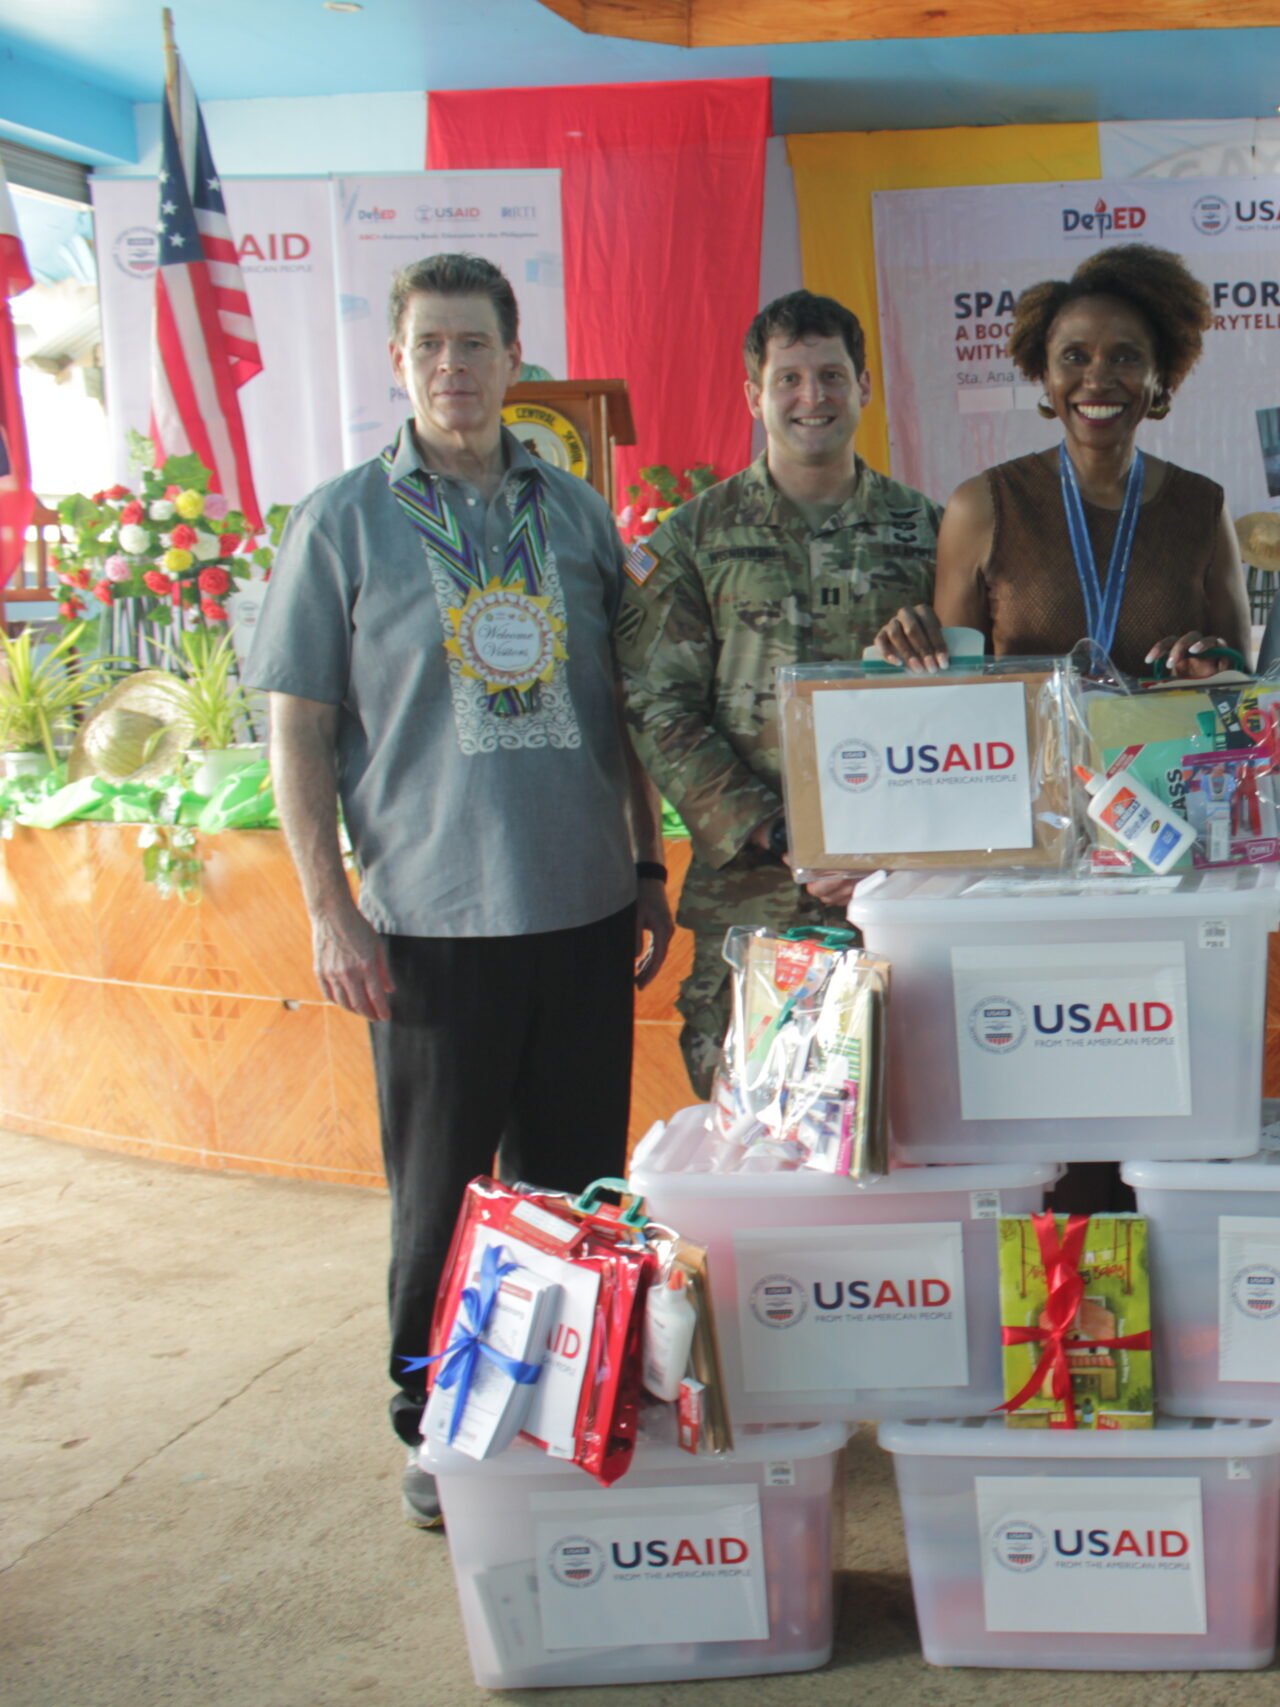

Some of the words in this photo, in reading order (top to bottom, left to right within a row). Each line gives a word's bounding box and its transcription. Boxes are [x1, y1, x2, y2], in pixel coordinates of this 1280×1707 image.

[434, 207, 480, 218] USAID
[1213, 281, 1280, 308] FOR
[956, 325, 969, 340] A
[479, 623, 533, 640] Welcome
[886, 741, 1015, 774] USAID
[888, 778, 914, 787] FROM
[916, 777, 935, 786] THE
[935, 775, 983, 786] AMERICAN
[985, 773, 1017, 783] PEOPLE
[1166, 768, 1188, 822] ASS
[1033, 1002, 1174, 1034] USAID
[1034, 1039, 1062, 1049] FROM
[1066, 1038, 1085, 1048] THE
[1087, 1037, 1138, 1047] AMERICAN
[1141, 1036, 1175, 1046] PEOPLE
[814, 1279, 952, 1310] USAID
[815, 1313, 842, 1323] FROM
[846, 1313, 864, 1322] THE
[867, 1312, 916, 1321] AMERICAN
[919, 1311, 953, 1320] PEOPLE
[1054, 1529, 1190, 1557] USAID
[612, 1537, 749, 1569] USAID
[613, 1572, 641, 1581] FROM
[644, 1571, 663, 1580] THE
[665, 1570, 715, 1579] AMERICAN
[718, 1568, 750, 1578] PEOPLE
[1055, 1561, 1082, 1569] FROM
[1086, 1561, 1103, 1569] THE
[1106, 1561, 1156, 1570] AMERICAN
[1158, 1561, 1191, 1571] PEOPLE
